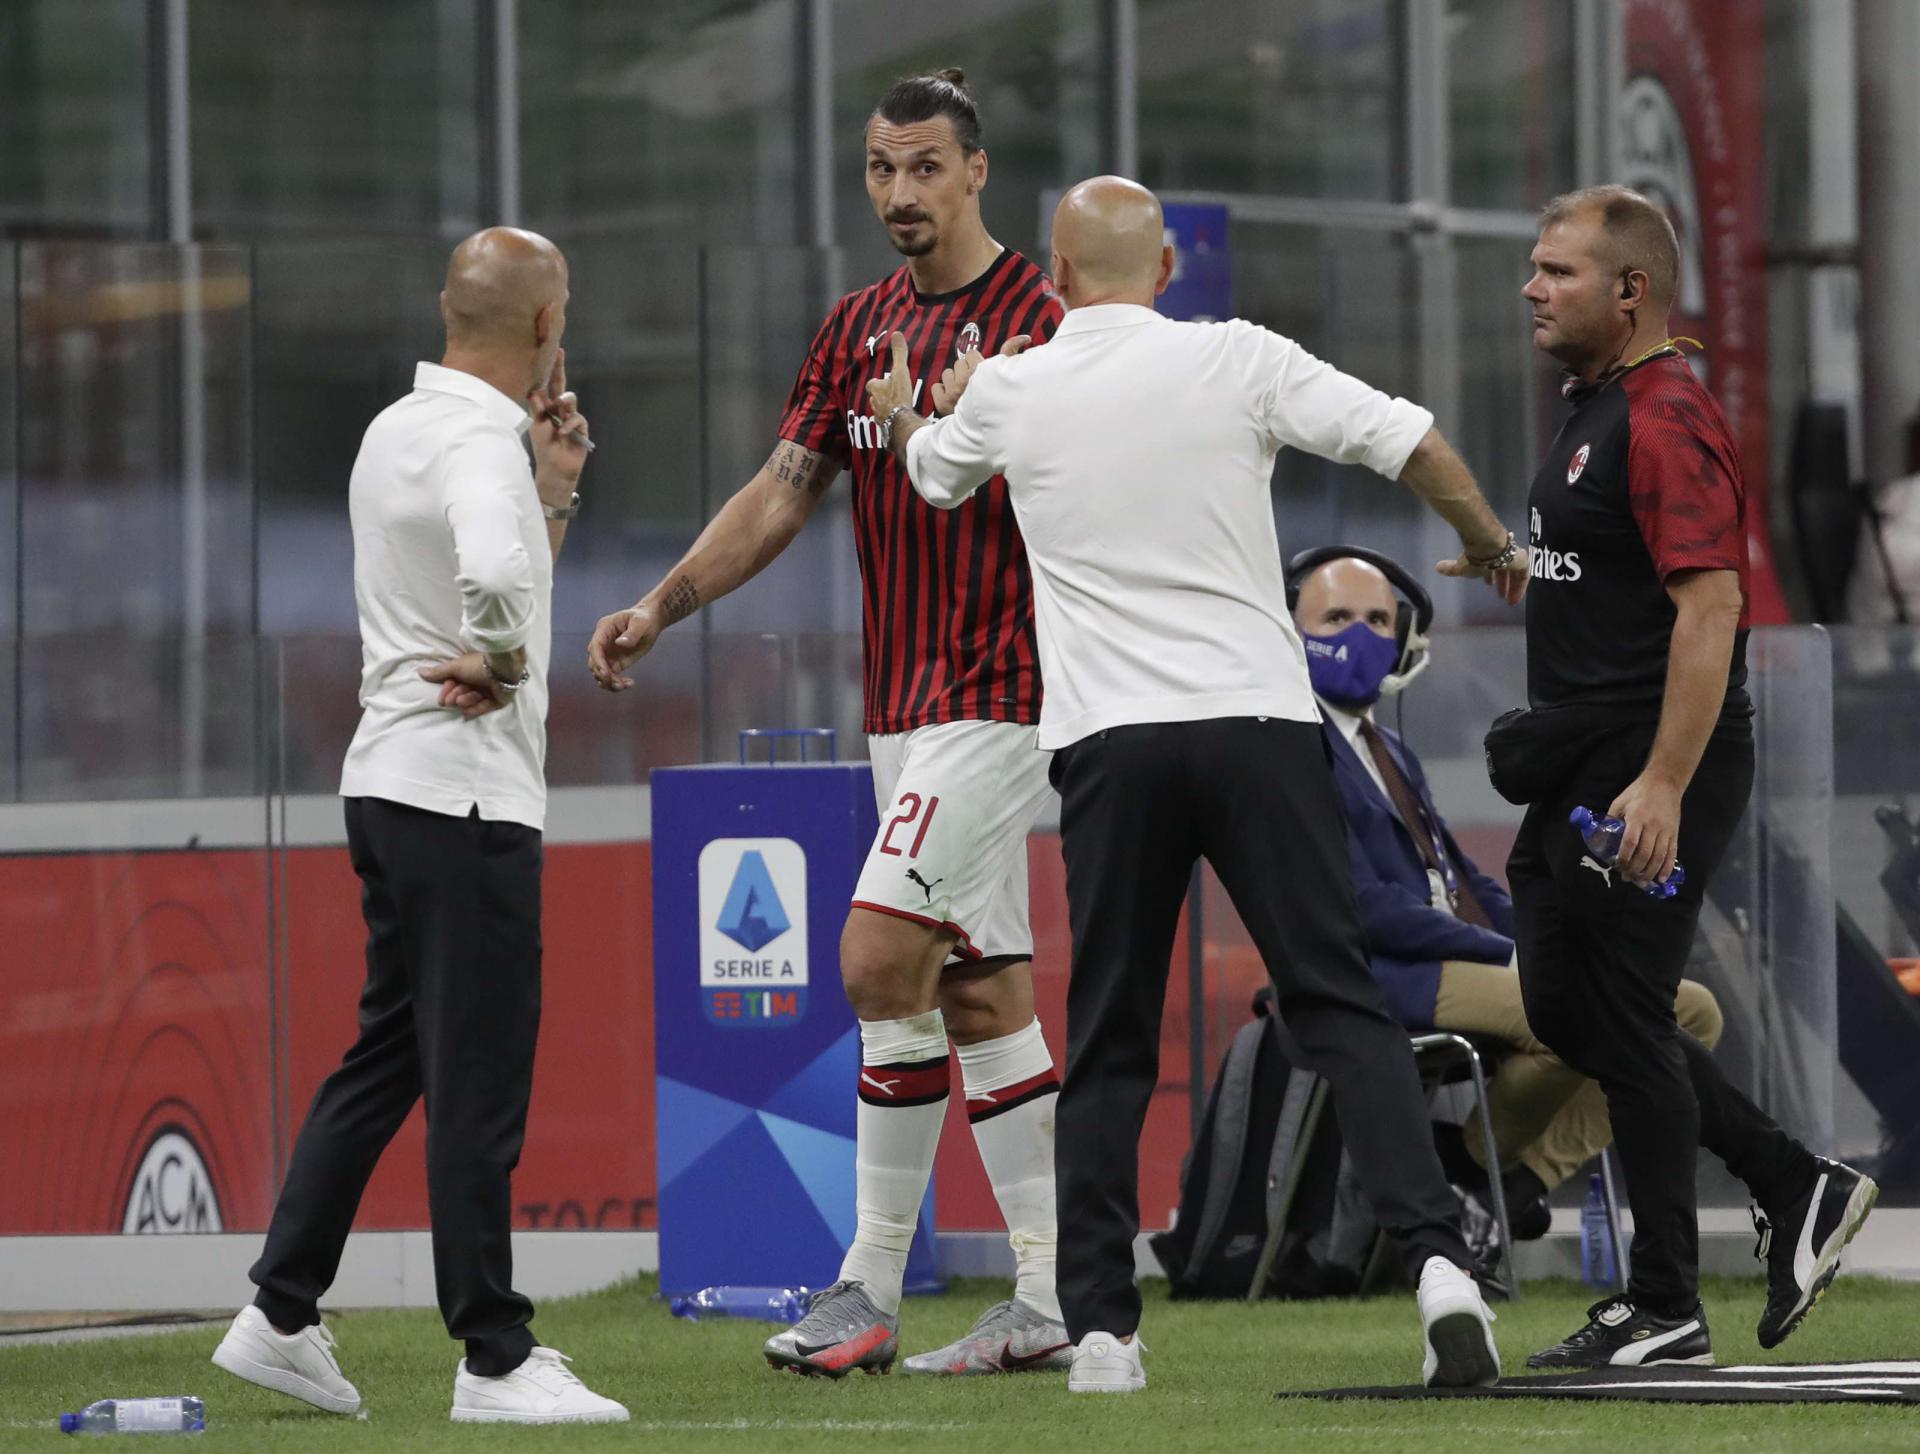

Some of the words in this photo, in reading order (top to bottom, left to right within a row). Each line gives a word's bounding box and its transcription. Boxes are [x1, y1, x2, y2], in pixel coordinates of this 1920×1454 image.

[880, 792, 939, 859] 21
[713, 959, 773, 979] SERIE
[780, 961, 795, 978] A
[744, 991, 798, 1019] TIM
[137, 1152, 208, 1232] ACM
